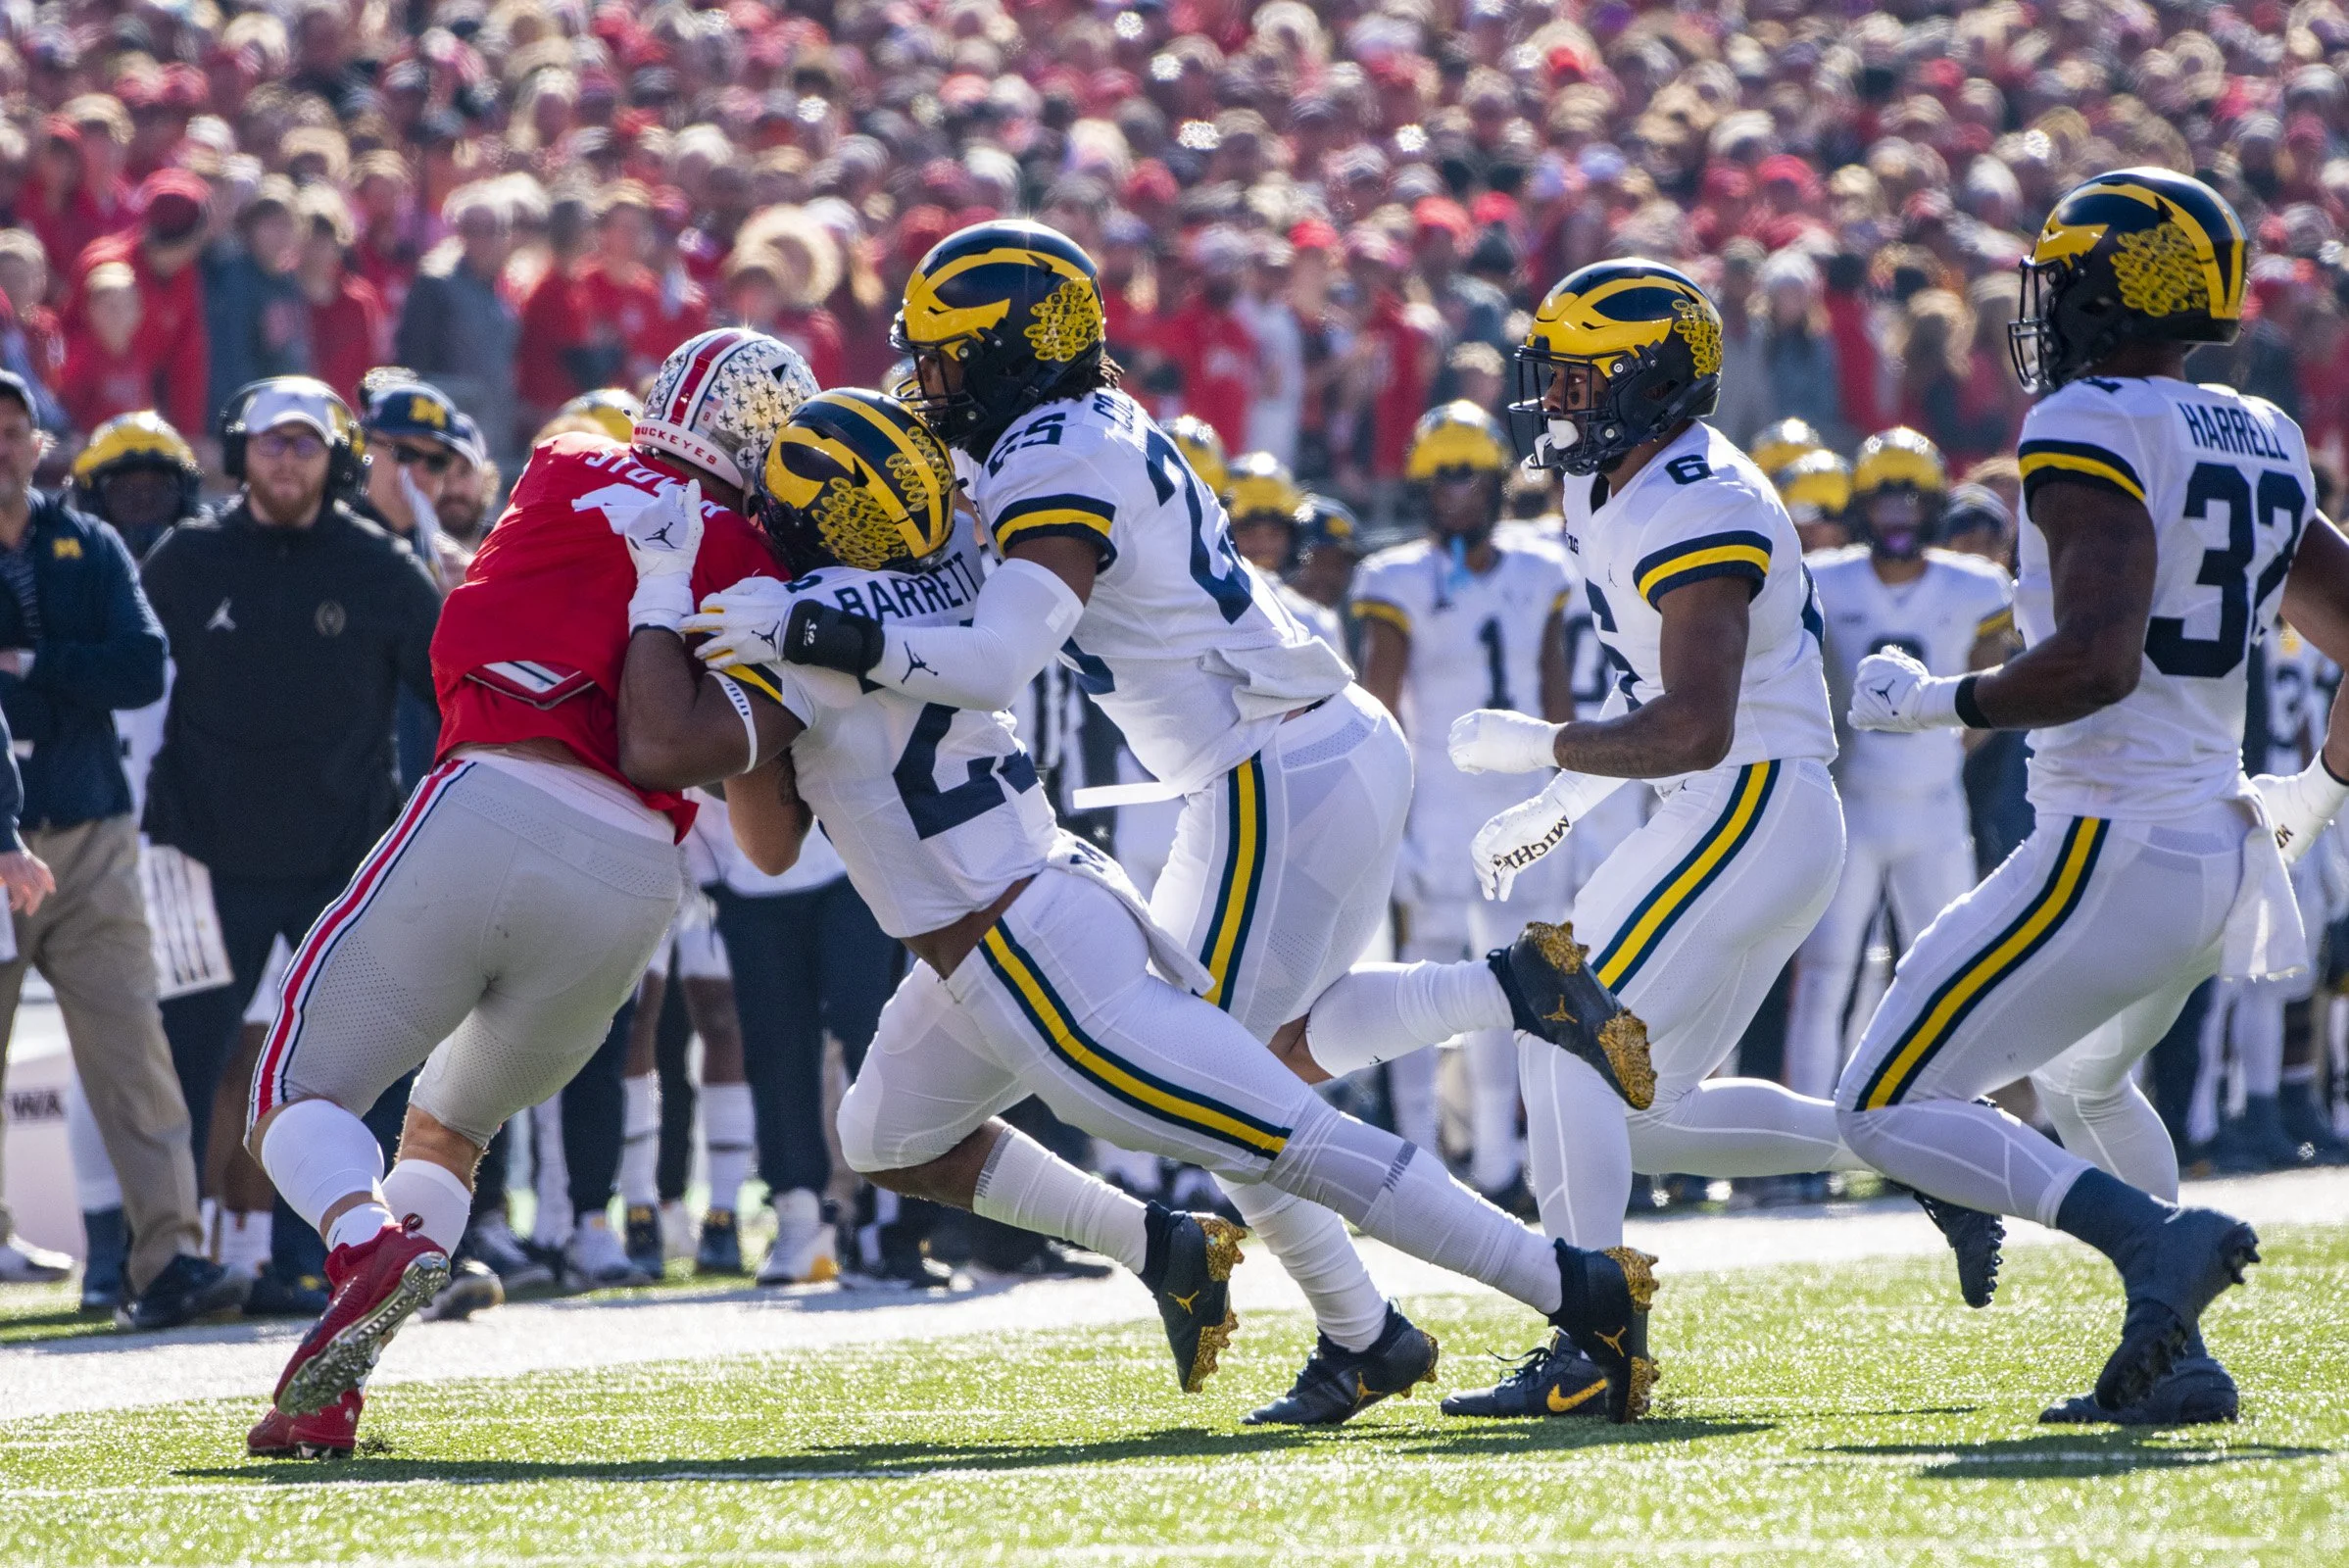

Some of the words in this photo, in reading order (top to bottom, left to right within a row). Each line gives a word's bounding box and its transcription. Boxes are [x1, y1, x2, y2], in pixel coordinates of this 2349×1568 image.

[411, 396, 447, 429] M
[2177, 402, 2291, 462] HARRELL
[634, 426, 717, 465] BUCKEYES
[988, 412, 1066, 479] 25
[1665, 454, 1713, 485] 6
[834, 551, 980, 623] BARRETT
[2144, 461, 2307, 678] 32
[1480, 614, 1515, 710] 1
